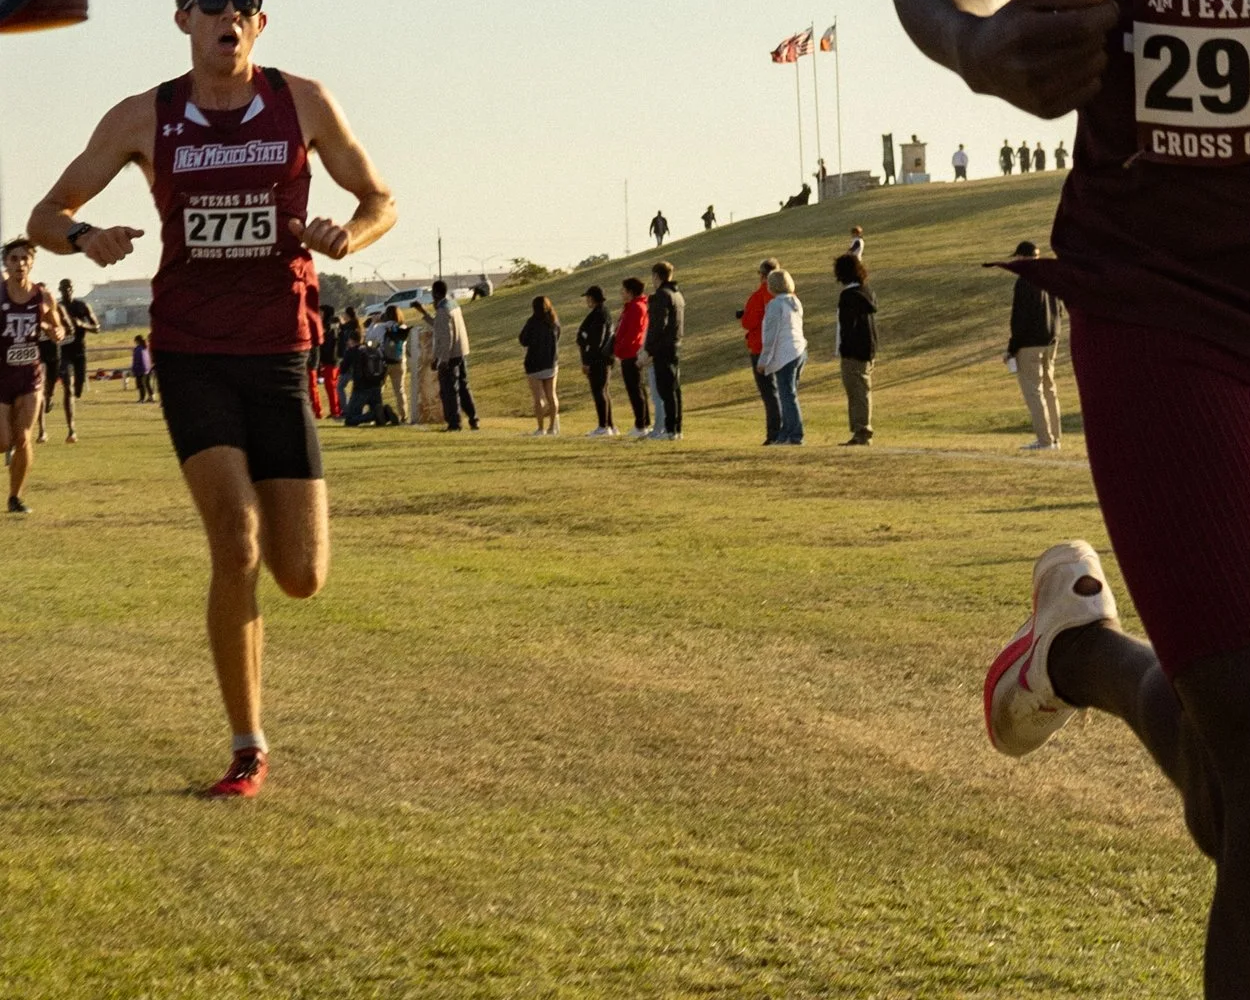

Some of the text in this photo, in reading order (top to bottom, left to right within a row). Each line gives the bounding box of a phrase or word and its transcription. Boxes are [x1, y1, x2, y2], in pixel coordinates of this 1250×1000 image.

[1151, 129, 1233, 159] CROSS
[200, 194, 240, 208] TEXAS
[188, 211, 272, 242] 2775
[191, 245, 272, 259] CROSS COUNTRY
